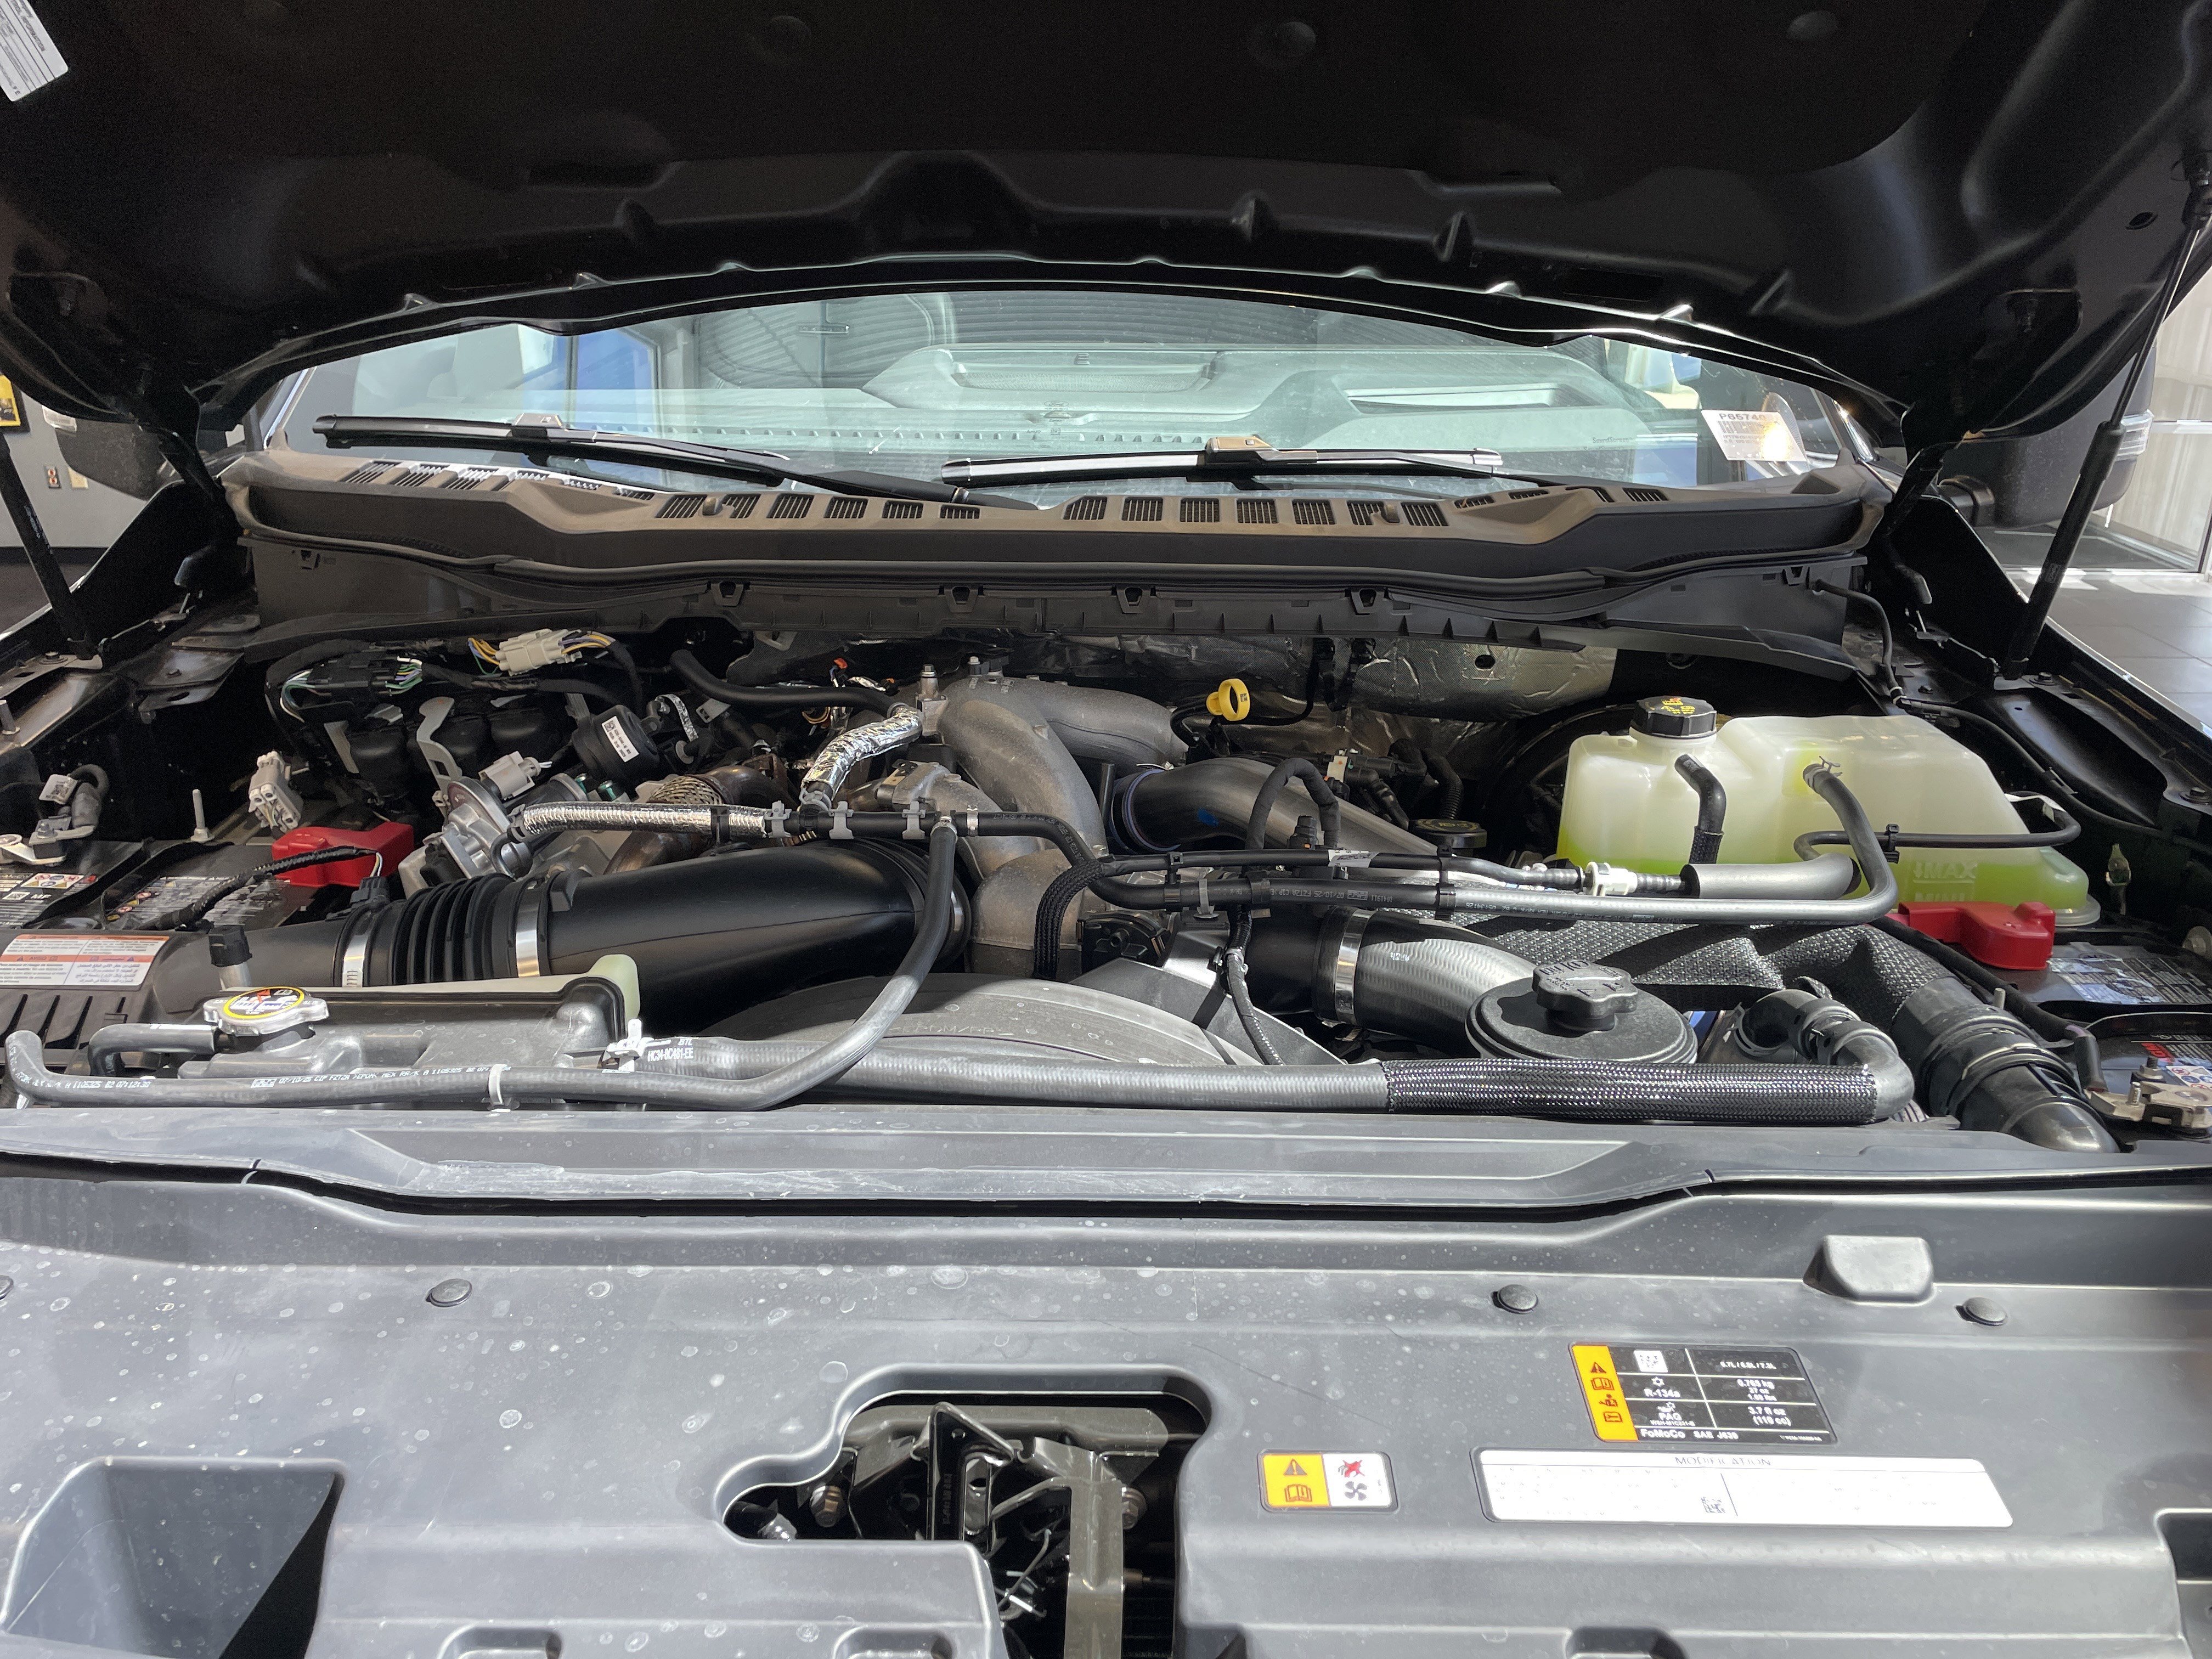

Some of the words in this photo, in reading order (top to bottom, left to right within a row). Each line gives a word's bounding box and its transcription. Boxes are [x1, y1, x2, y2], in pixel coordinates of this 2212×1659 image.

[1923, 862, 1977, 878] MAX
[1644, 1388, 1681, 1398] R-134a
[1747, 1406, 1762, 1415] 3.7
[1658, 1412, 1682, 1421] PAG
[1640, 1429, 1686, 1438] FoMoCo
